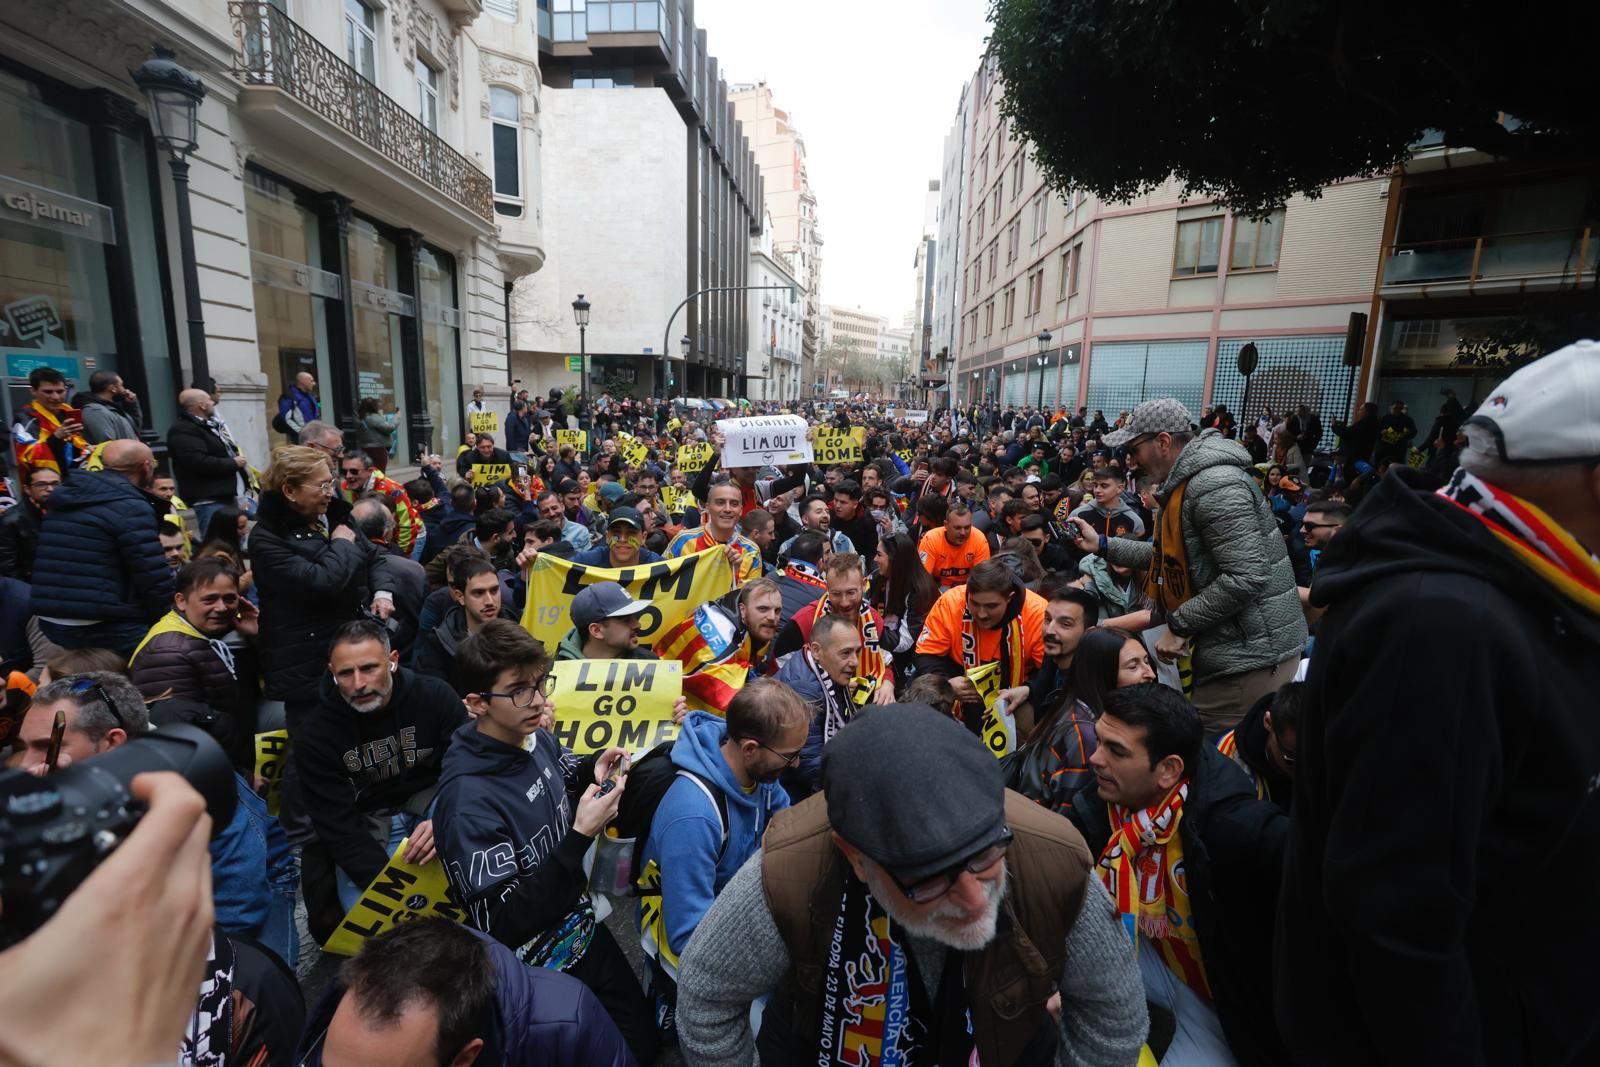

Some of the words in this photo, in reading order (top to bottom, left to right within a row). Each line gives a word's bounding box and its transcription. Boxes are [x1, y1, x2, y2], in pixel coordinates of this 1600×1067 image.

[3, 192, 93, 227] cajamar
[476, 411, 492, 420] LIM
[473, 423, 497, 432] HOME
[741, 418, 798, 428] DIGNITAT
[562, 430, 580, 438] LIM
[817, 427, 851, 438] LIM
[684, 443, 707, 455] LIM
[742, 436, 769, 450] LIM
[773, 435, 796, 449] OUT
[825, 438, 843, 448] GO
[691, 451, 702, 460] GO
[814, 446, 862, 461] HOME
[480, 465, 506, 474] LIM
[679, 460, 708, 471] HOM
[668, 487, 689, 497] LIM
[671, 495, 683, 503] GO
[562, 555, 700, 600] LIM
[575, 662, 657, 692] LIM
[593, 695, 637, 717] GO
[553, 719, 675, 750] HOME
[342, 866, 418, 938] LIM
[828, 916, 845, 968] EUROPA
[827, 976, 838, 992] 23
[824, 994, 836, 1011] DE
[820, 1011, 835, 1049] MAYO
